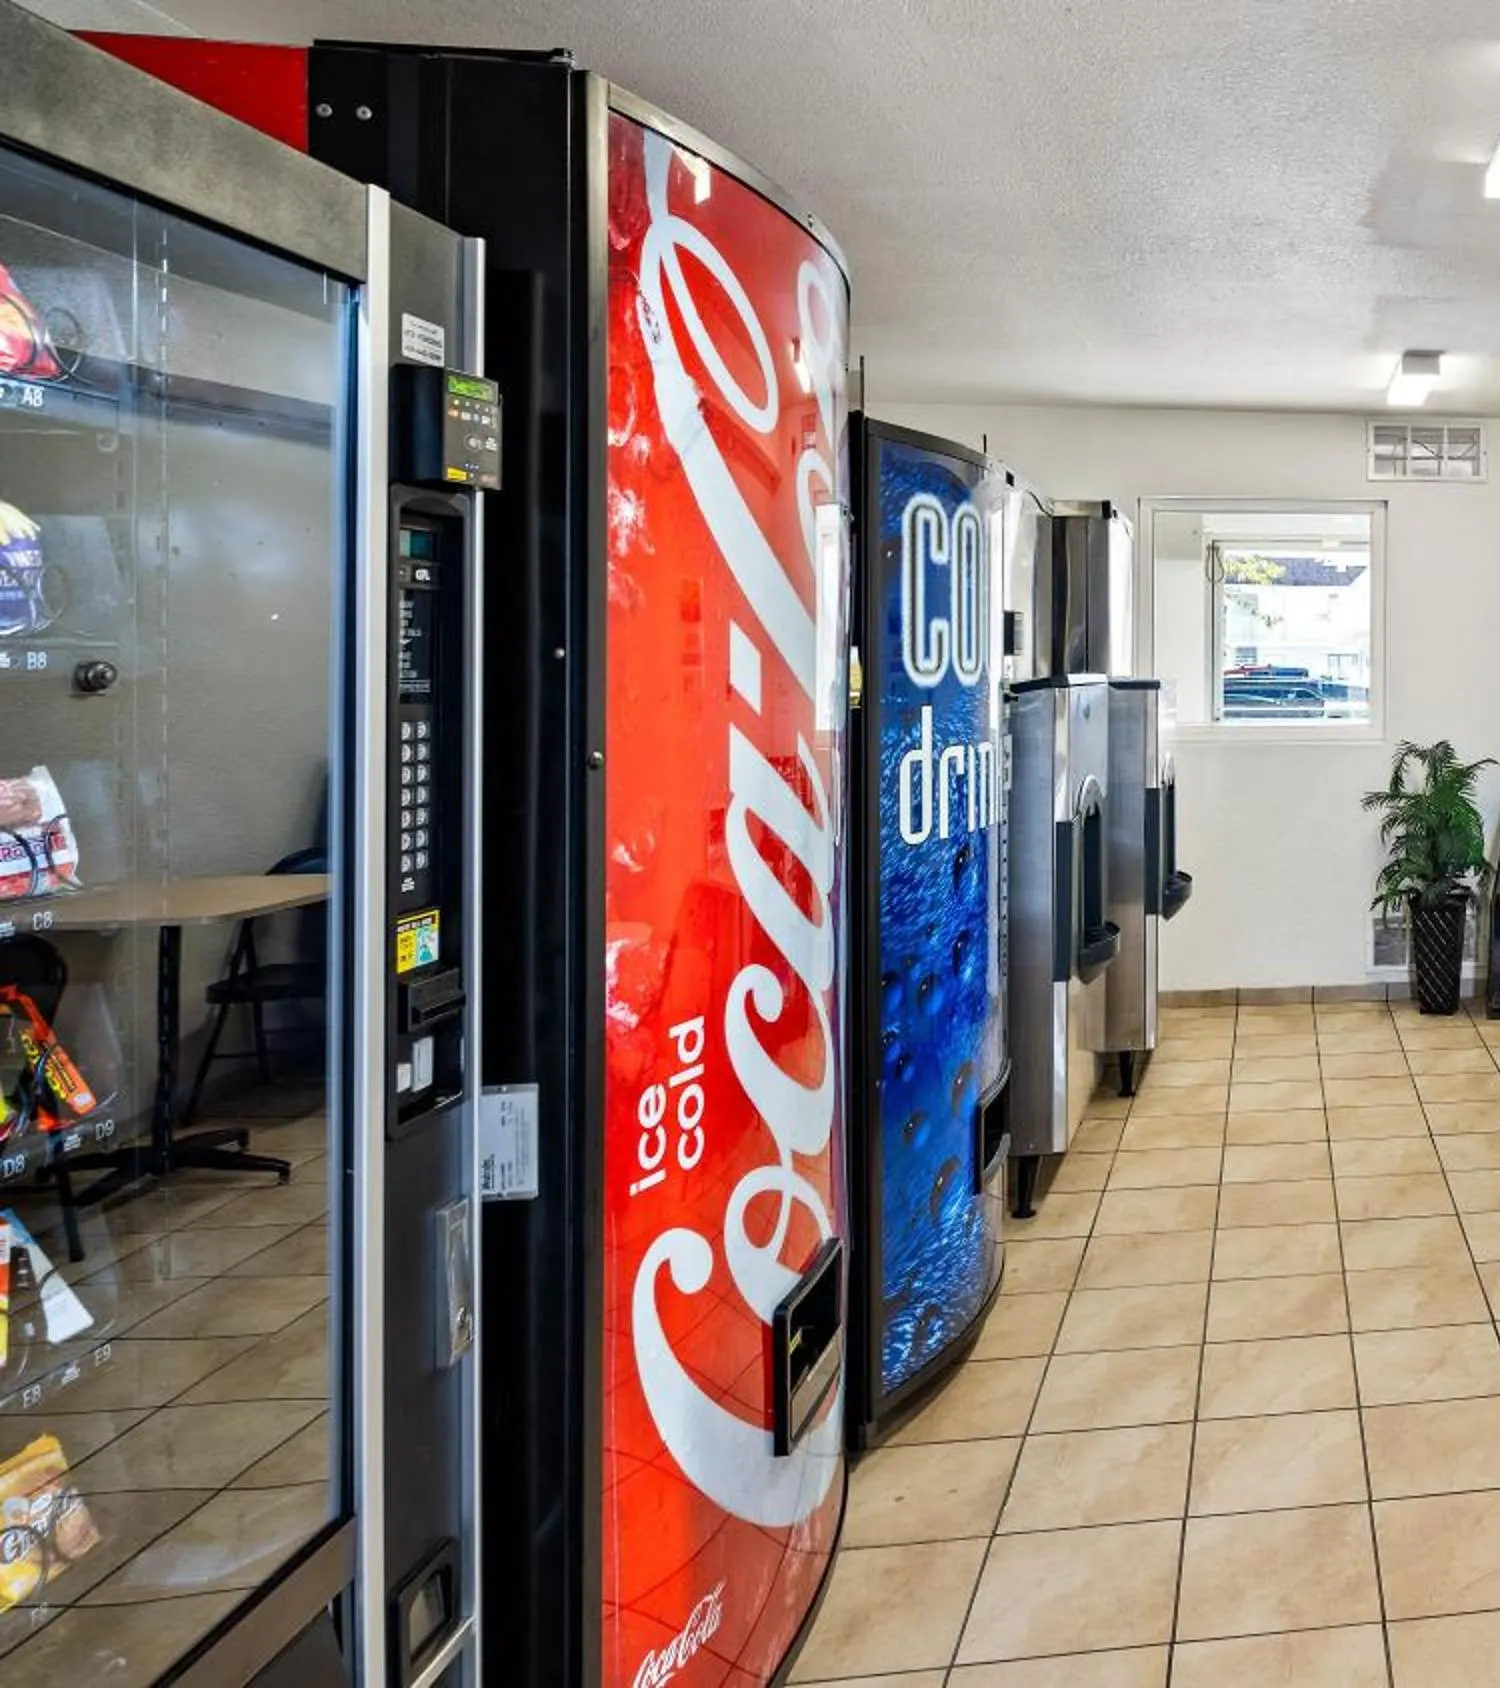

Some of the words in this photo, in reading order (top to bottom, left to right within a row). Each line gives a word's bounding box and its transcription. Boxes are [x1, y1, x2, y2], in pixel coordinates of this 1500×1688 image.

[21, 386, 45, 408] A8
[26, 651, 48, 671] B8
[32, 911, 54, 931] C8
[668, 1015, 705, 1171] cold
[95, 1118, 115, 1142] D9
[629, 1084, 667, 1197] ice
[2, 1153, 26, 1178] D8
